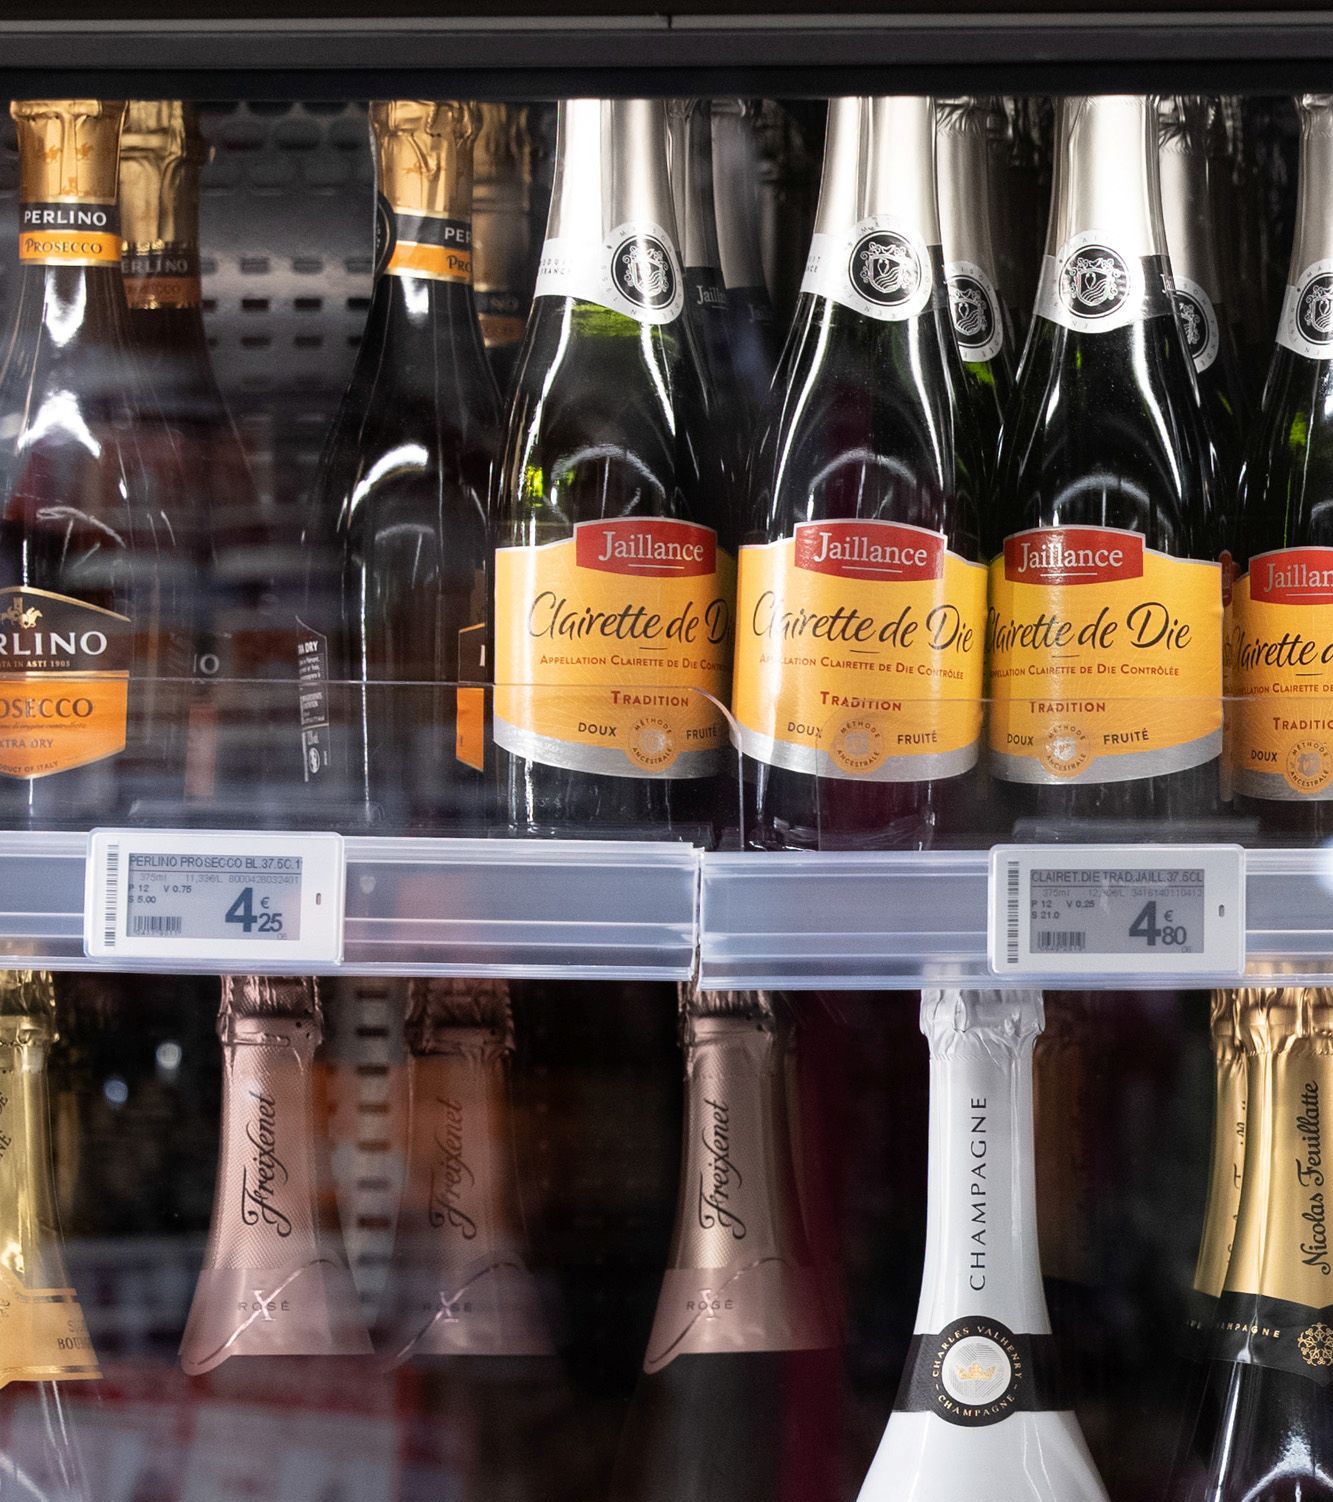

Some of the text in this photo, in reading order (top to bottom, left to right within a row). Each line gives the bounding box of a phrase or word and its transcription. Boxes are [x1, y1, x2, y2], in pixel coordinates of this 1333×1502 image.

[23, 209, 107, 226] PERLINO
[24, 238, 102, 256] PROSECCO
[598, 531, 704, 562] Jaillance
[815, 533, 927, 566] Jaillance
[1018, 542, 1123, 573] Jaillance
[529, 591, 699, 642] Clairette de
[752, 591, 974, 653] Clairette Die
[1127, 601, 1192, 649] Die
[611, 691, 688, 707] TRADITION
[820, 691, 901, 711] TRADITION
[1029, 701, 1106, 713] TRADITION
[578, 723, 617, 737] DOUX
[897, 730, 938, 745] FRUITÉ
[1007, 728, 1149, 746] DOUX FRUITÉ
[1251, 749, 1278, 762] DOUX
[180, 857, 242, 869] PROSECCO
[225, 887, 282, 932] 4 25
[1129, 900, 1187, 946] 4 80
[241, 1092, 292, 1238] Freixenet
[698, 1099, 746, 1240] Freixenet
[1296, 1079, 1331, 1275] Nicolas Feuillatte
[969, 1097, 987, 1291] CHAMPAGNE
